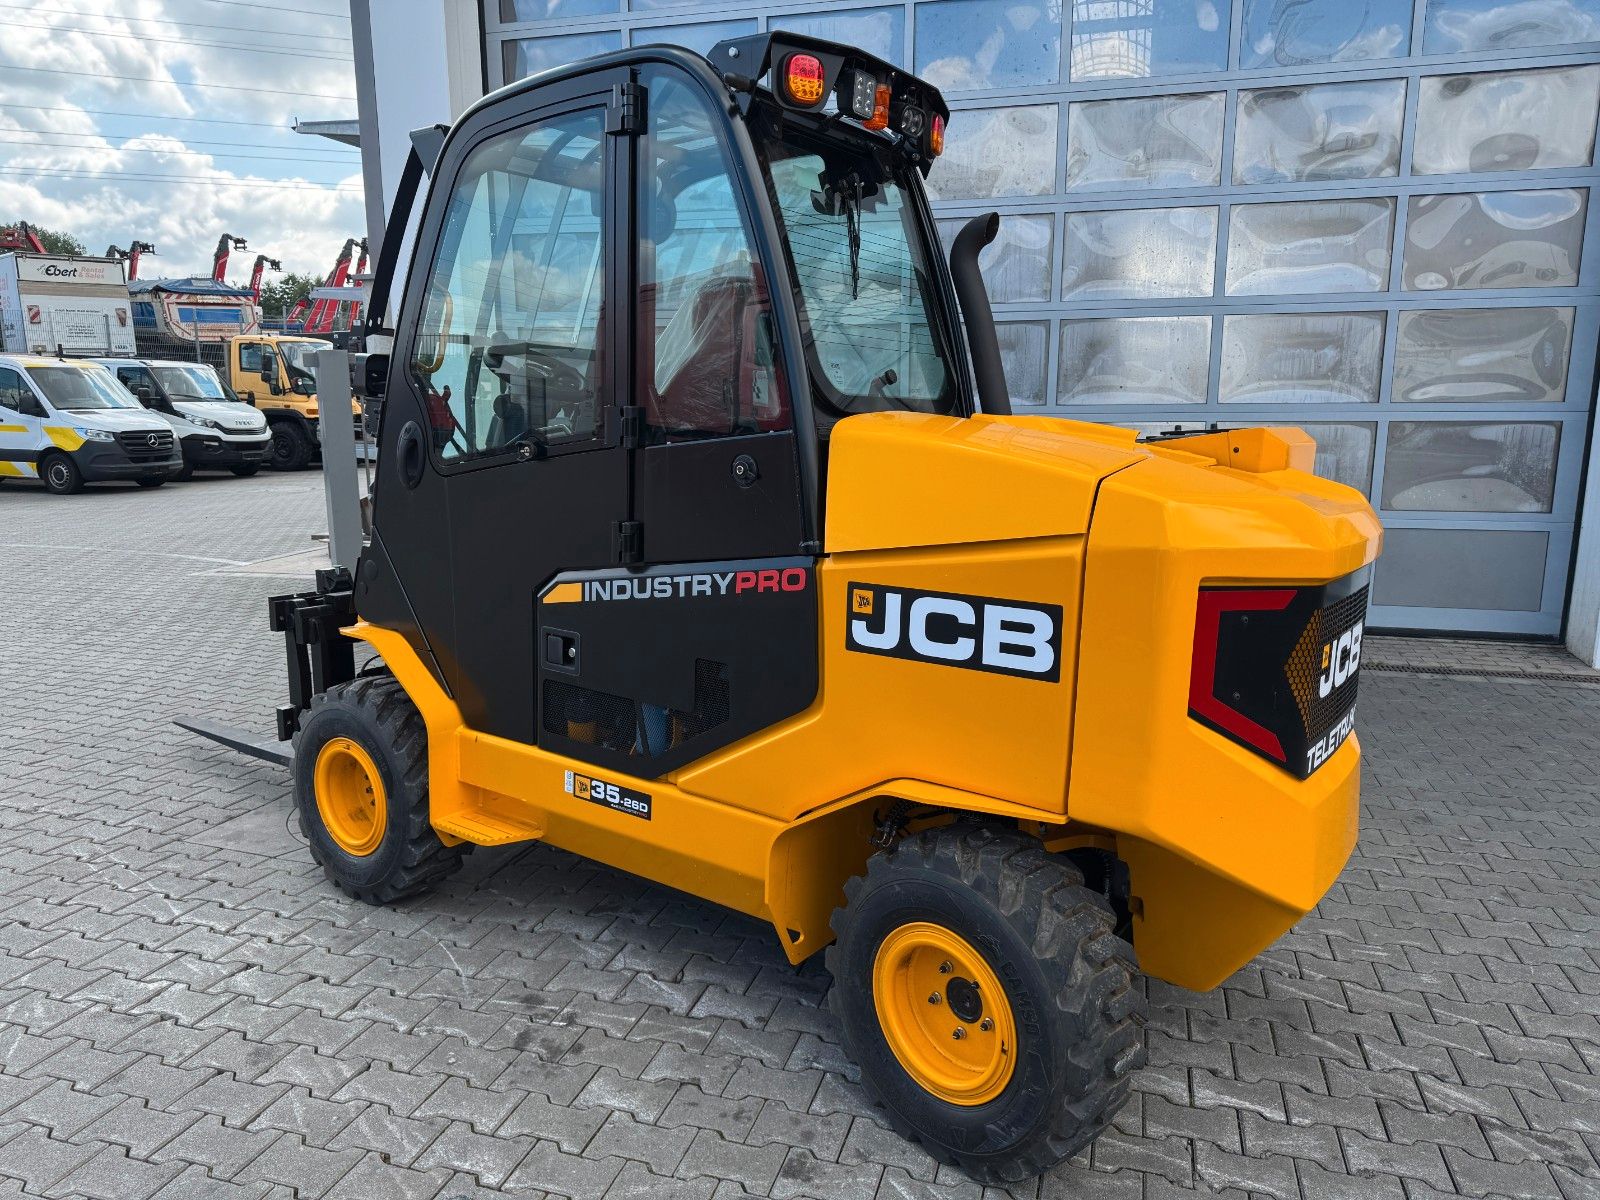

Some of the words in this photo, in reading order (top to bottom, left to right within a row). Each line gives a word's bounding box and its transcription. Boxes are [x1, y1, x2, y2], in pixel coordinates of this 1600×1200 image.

[45, 264, 77, 278] Ebert
[851, 592, 1055, 673] JCB
[1319, 622, 1363, 699] JCB
